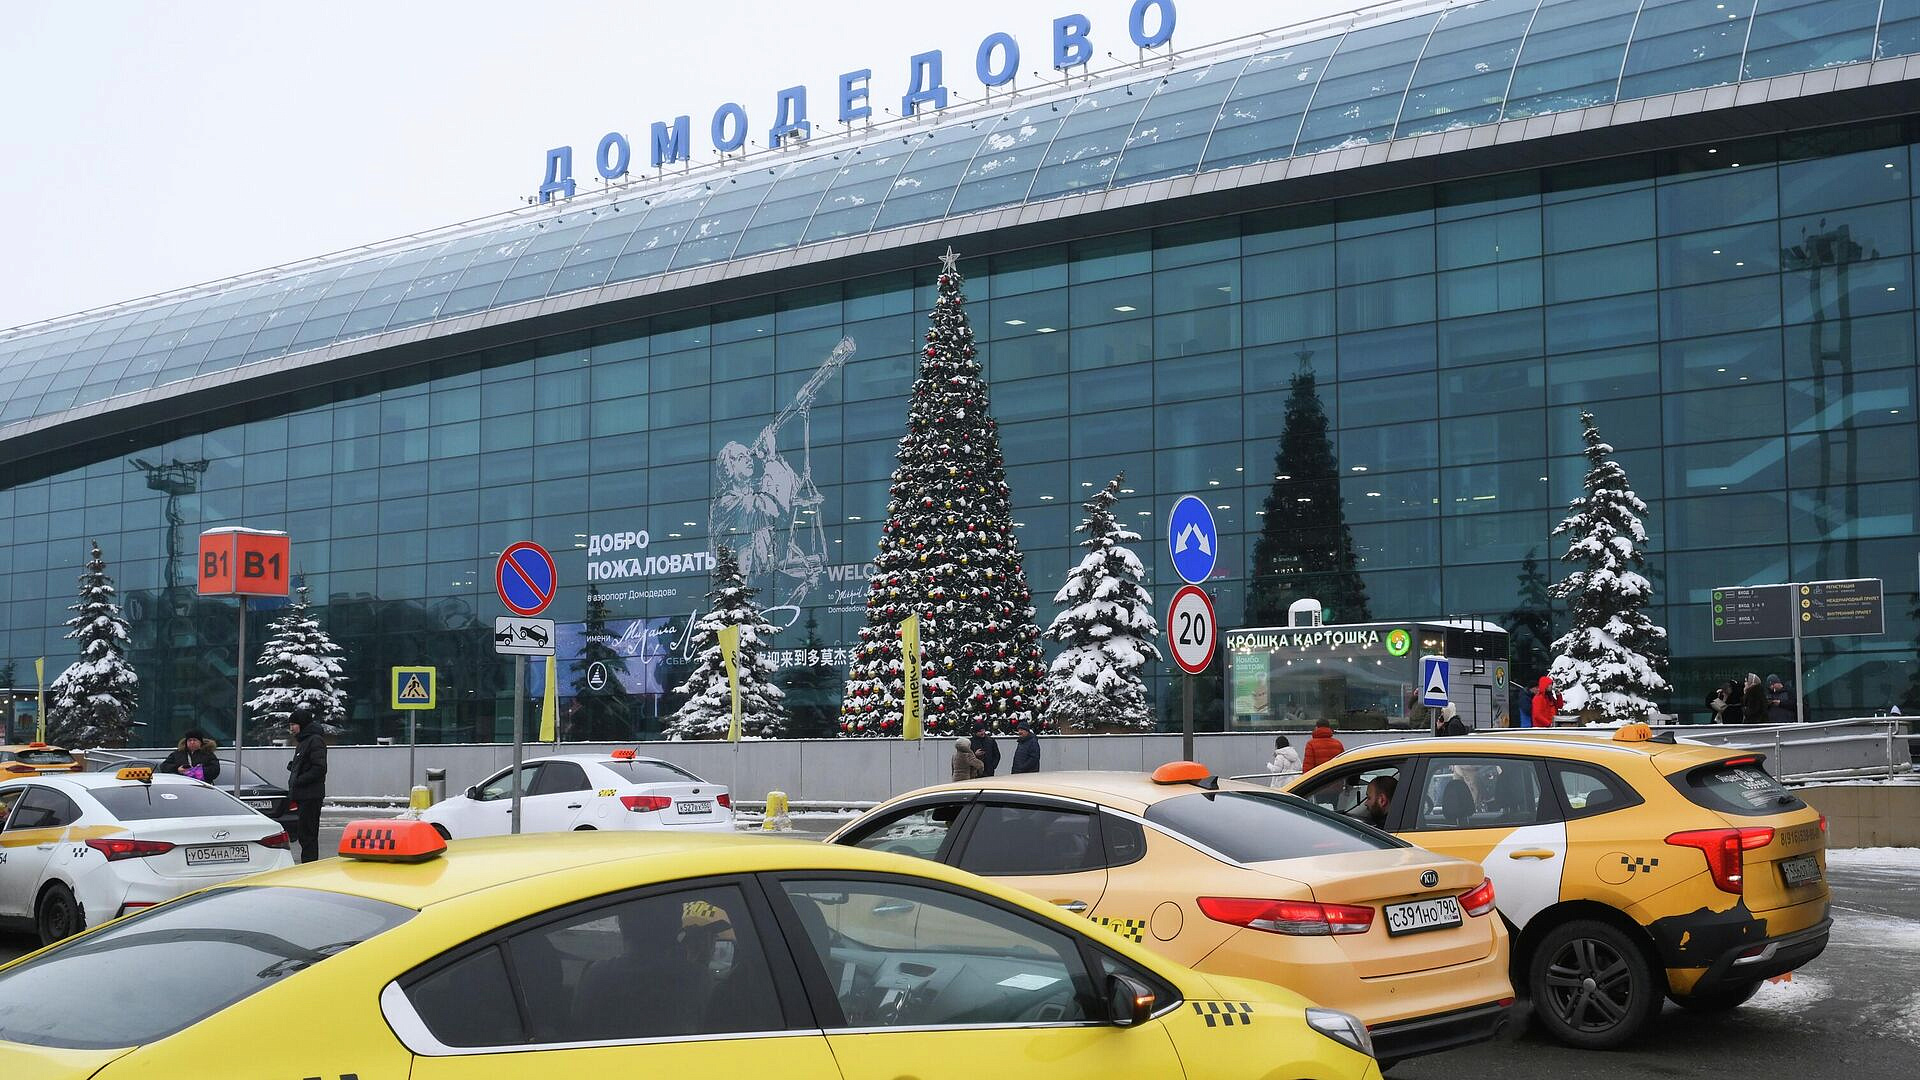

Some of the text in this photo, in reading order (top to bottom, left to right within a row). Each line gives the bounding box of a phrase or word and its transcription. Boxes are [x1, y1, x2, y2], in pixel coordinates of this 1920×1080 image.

[539, 0, 1177, 204] ДОМОДЕДОВО
[588, 530, 649, 557] ДОБРО
[588, 552, 717, 580] ПОЖАЛОВАТЬ
[588, 588, 677, 603] в аэропорт Домодедово
[828, 605, 866, 614] Domodedovo
[1178, 611, 1206, 646] 20
[1226, 630, 1379, 649] КРОШКА КАРТОШКА
[1424, 874, 1437, 884] KIA
